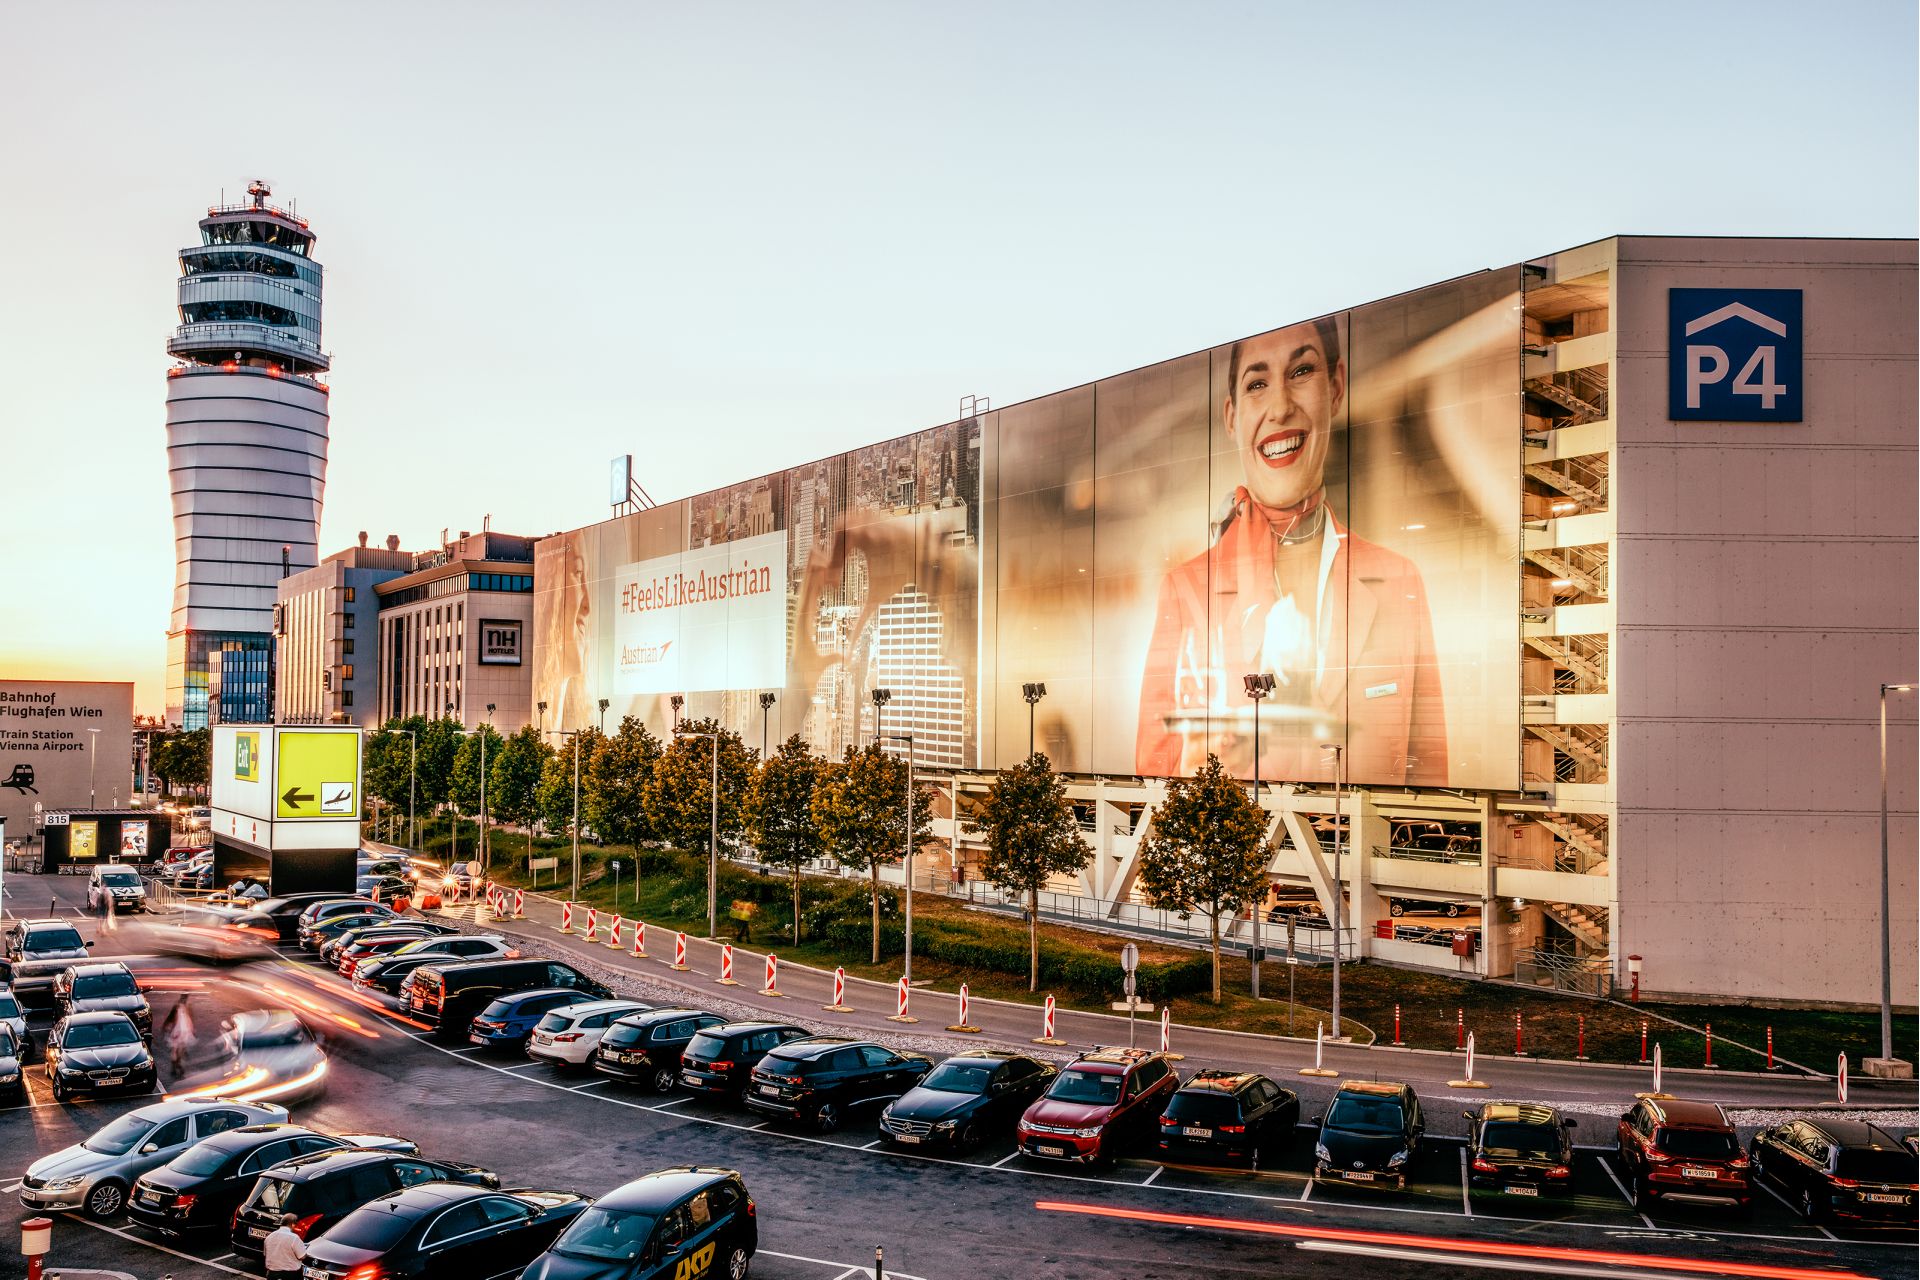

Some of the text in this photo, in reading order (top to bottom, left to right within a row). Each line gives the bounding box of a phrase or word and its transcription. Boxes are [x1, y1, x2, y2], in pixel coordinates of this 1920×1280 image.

[1686, 345, 1786, 409] P4
[622, 560, 771, 614] #FeelsLikeAustrian
[620, 643, 658, 665] Austrian
[0, 692, 56, 705] Bahnhof
[0, 706, 103, 719] Flughafen Wien
[0, 730, 73, 739] Train Station
[0, 741, 84, 752] Vienna Airport
[238, 741, 249, 769] Exit
[47, 815, 67, 825] 815
